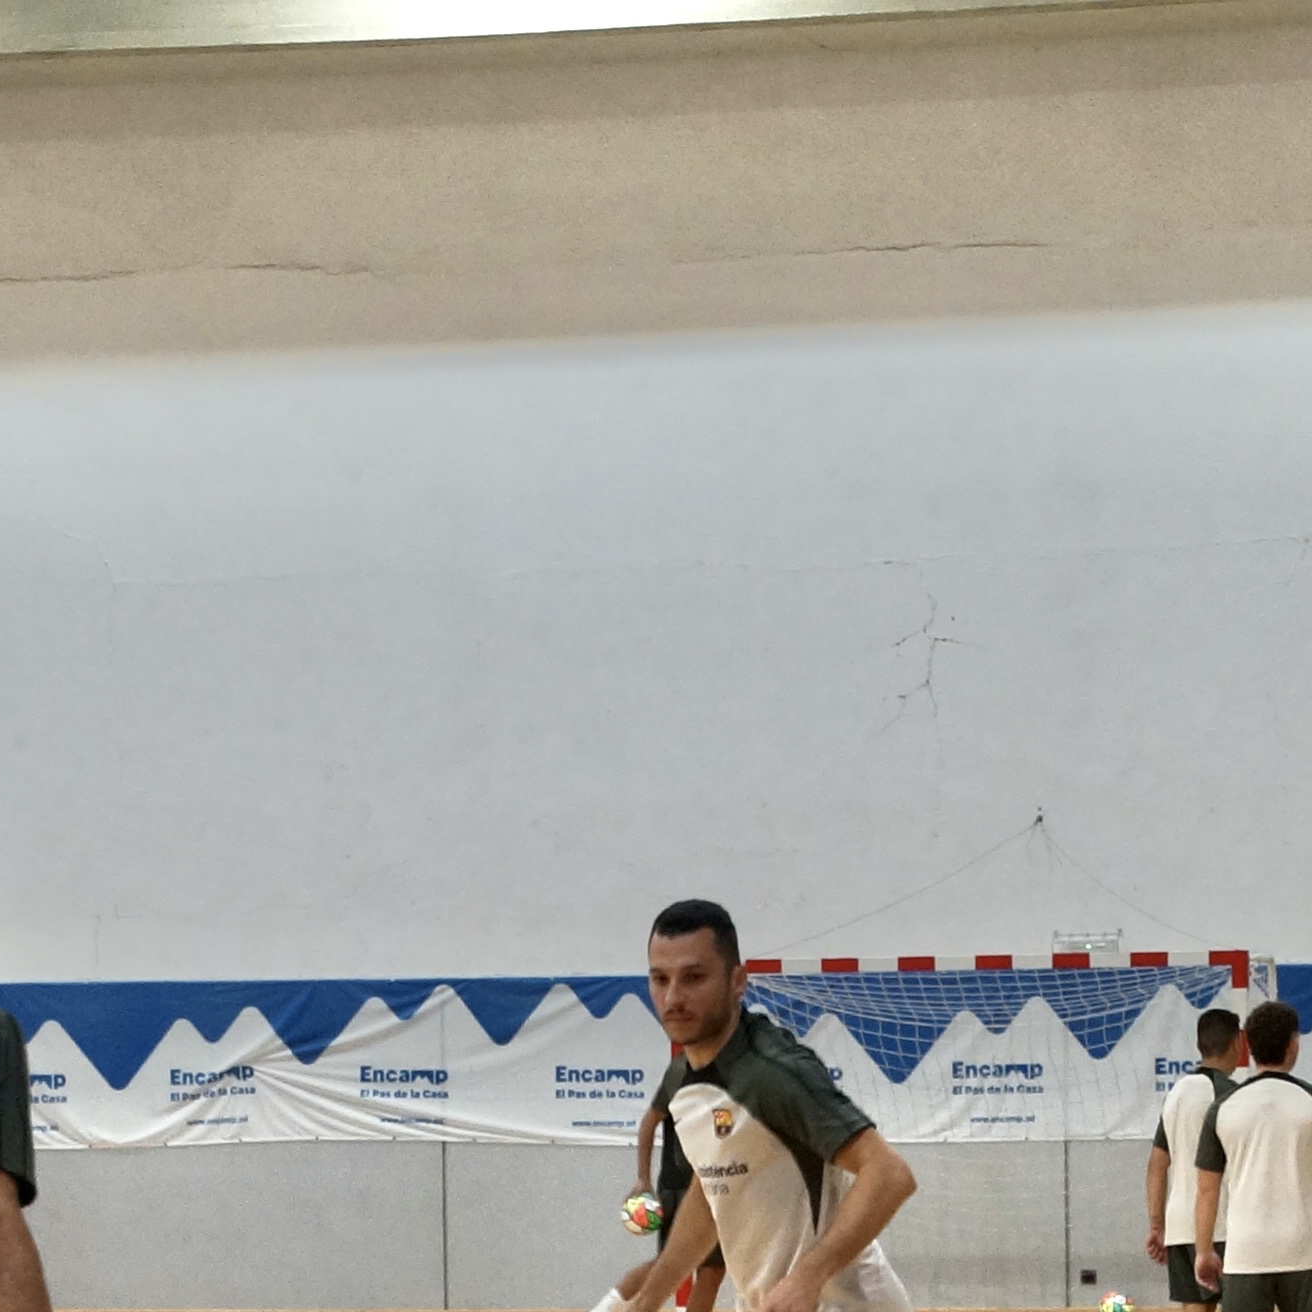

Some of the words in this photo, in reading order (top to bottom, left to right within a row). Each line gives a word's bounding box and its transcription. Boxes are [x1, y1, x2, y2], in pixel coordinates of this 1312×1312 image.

[170, 1065, 254, 1085] Encamp
[360, 1066, 448, 1085] Encamp
[555, 1066, 645, 1085] Encamp
[952, 1061, 1043, 1080] Encamp
[1155, 1058, 1203, 1075] Enc
